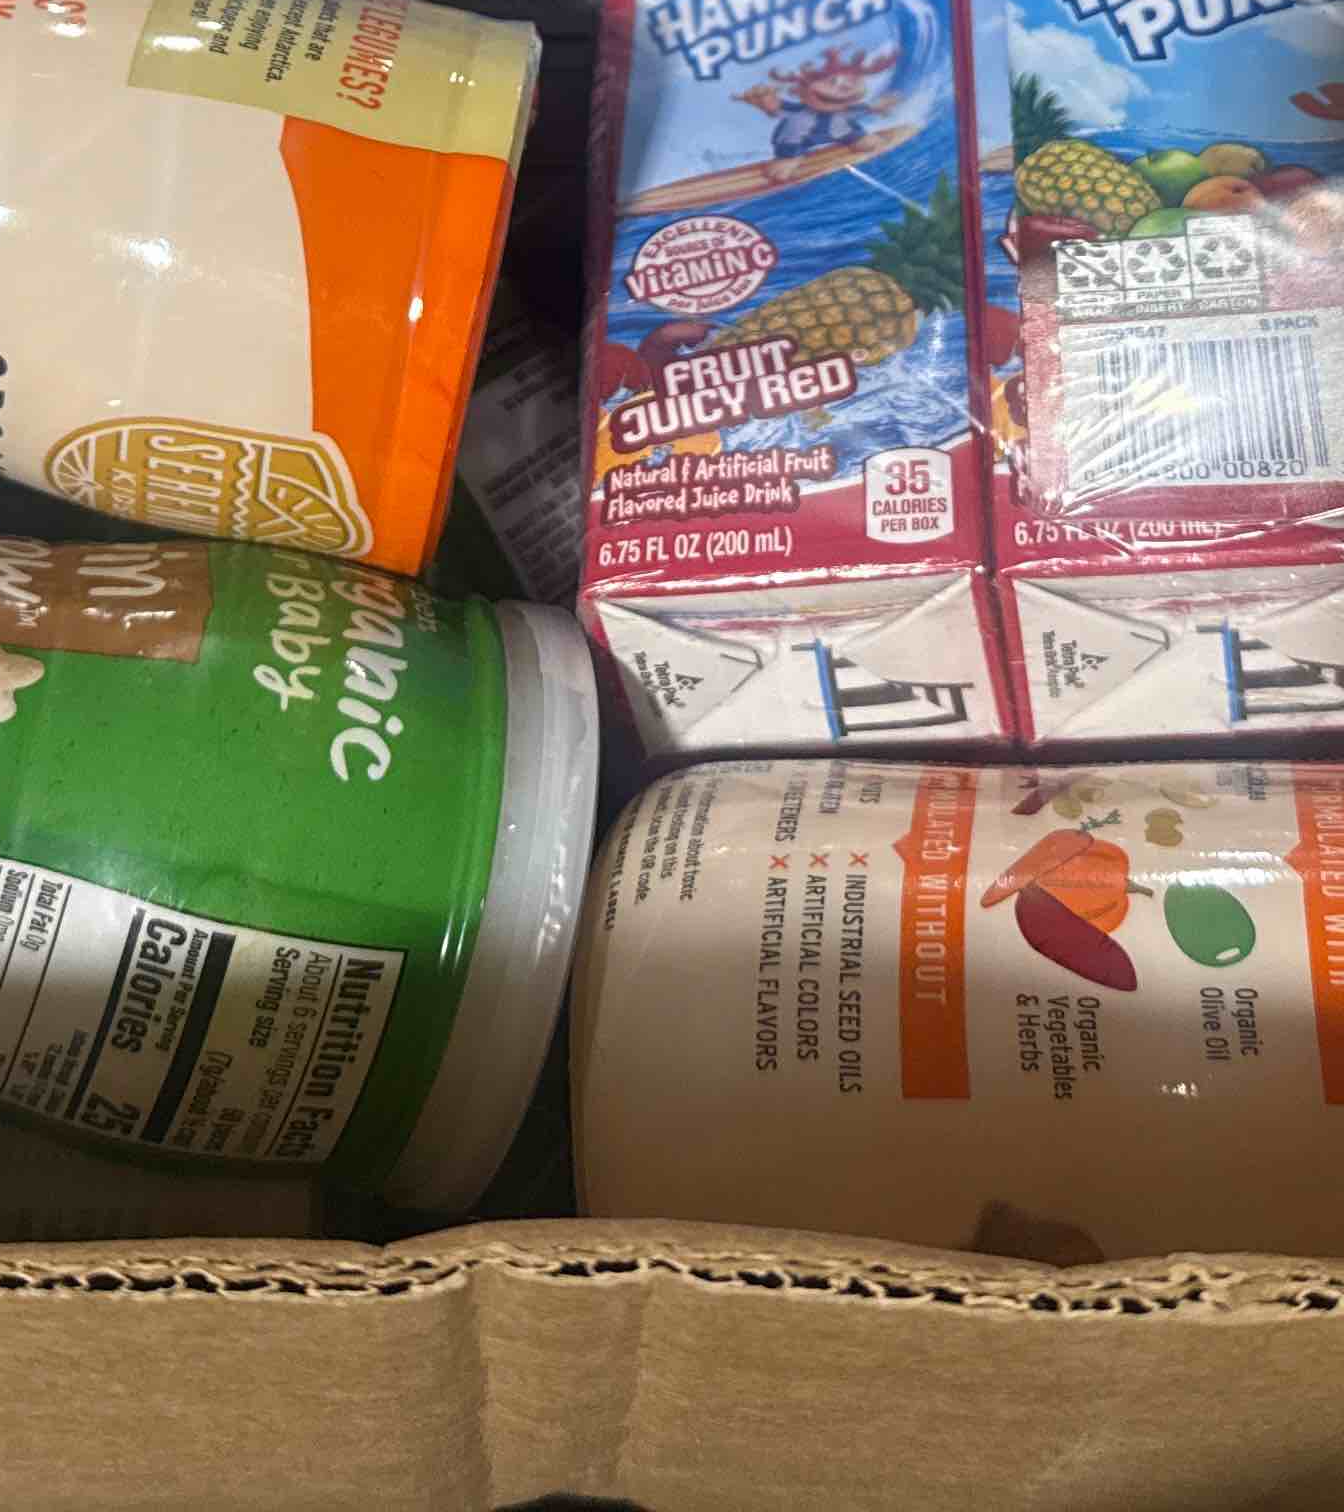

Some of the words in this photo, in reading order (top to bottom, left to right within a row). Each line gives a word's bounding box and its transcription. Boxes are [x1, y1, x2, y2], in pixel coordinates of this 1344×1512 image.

[337, 6, 400, 110] LEGUMES?
[663, 341, 793, 397] FRUIT
[620, 392, 749, 445] JUICY
[758, 359, 851, 410] RED
[610, 460, 678, 489] Natural
[697, 451, 777, 482] Artificial
[785, 449, 831, 474] Fruit
[884, 460, 929, 494] 35
[609, 489, 686, 521] Flavored
[692, 484, 738, 510] Juice
[745, 480, 793, 507] Drink
[872, 498, 947, 517] CALORIES
[880, 517, 906, 532] PER
[910, 514, 940, 530] BOX
[600, 536, 643, 566] 6.75
[647, 535, 667, 561] FL
[674, 532, 701, 558] OZ
[705, 529, 744, 558] (200
[751, 525, 792, 555] mL)
[252, 574, 324, 711] Baby
[330, 572, 407, 783] rganic
[29, 912, 51, 933] Fat
[32, 881, 62, 909] Total
[799, 874, 826, 973] ARTIFICIAL
[760, 877, 787, 973] ARTIFICIAL
[840, 874, 866, 983] INDUSTRIAL
[913, 874, 947, 1007] WITHOUT
[112, 920, 186, 1052] Calories
[259, 947, 299, 1011] Serving
[249, 1015, 276, 1049] size
[305, 959, 385, 1096] Nutrition
[755, 978, 781, 1072] FLAVORS
[795, 978, 820, 1061] COLORS
[840, 990, 860, 1043] SEED
[1076, 997, 1104, 1072] Organic
[1200, 987, 1225, 1033] Olive
[1233, 987, 1263, 1056] Organic
[839, 1050, 861, 1094] OILS
[1018, 1014, 1042, 1072] Herbs
[1046, 995, 1074, 1100] Vegetables
[1203, 1038, 1231, 1061] Oil
[82, 1095, 142, 1134] 25
[277, 1106, 336, 1159] Facts
